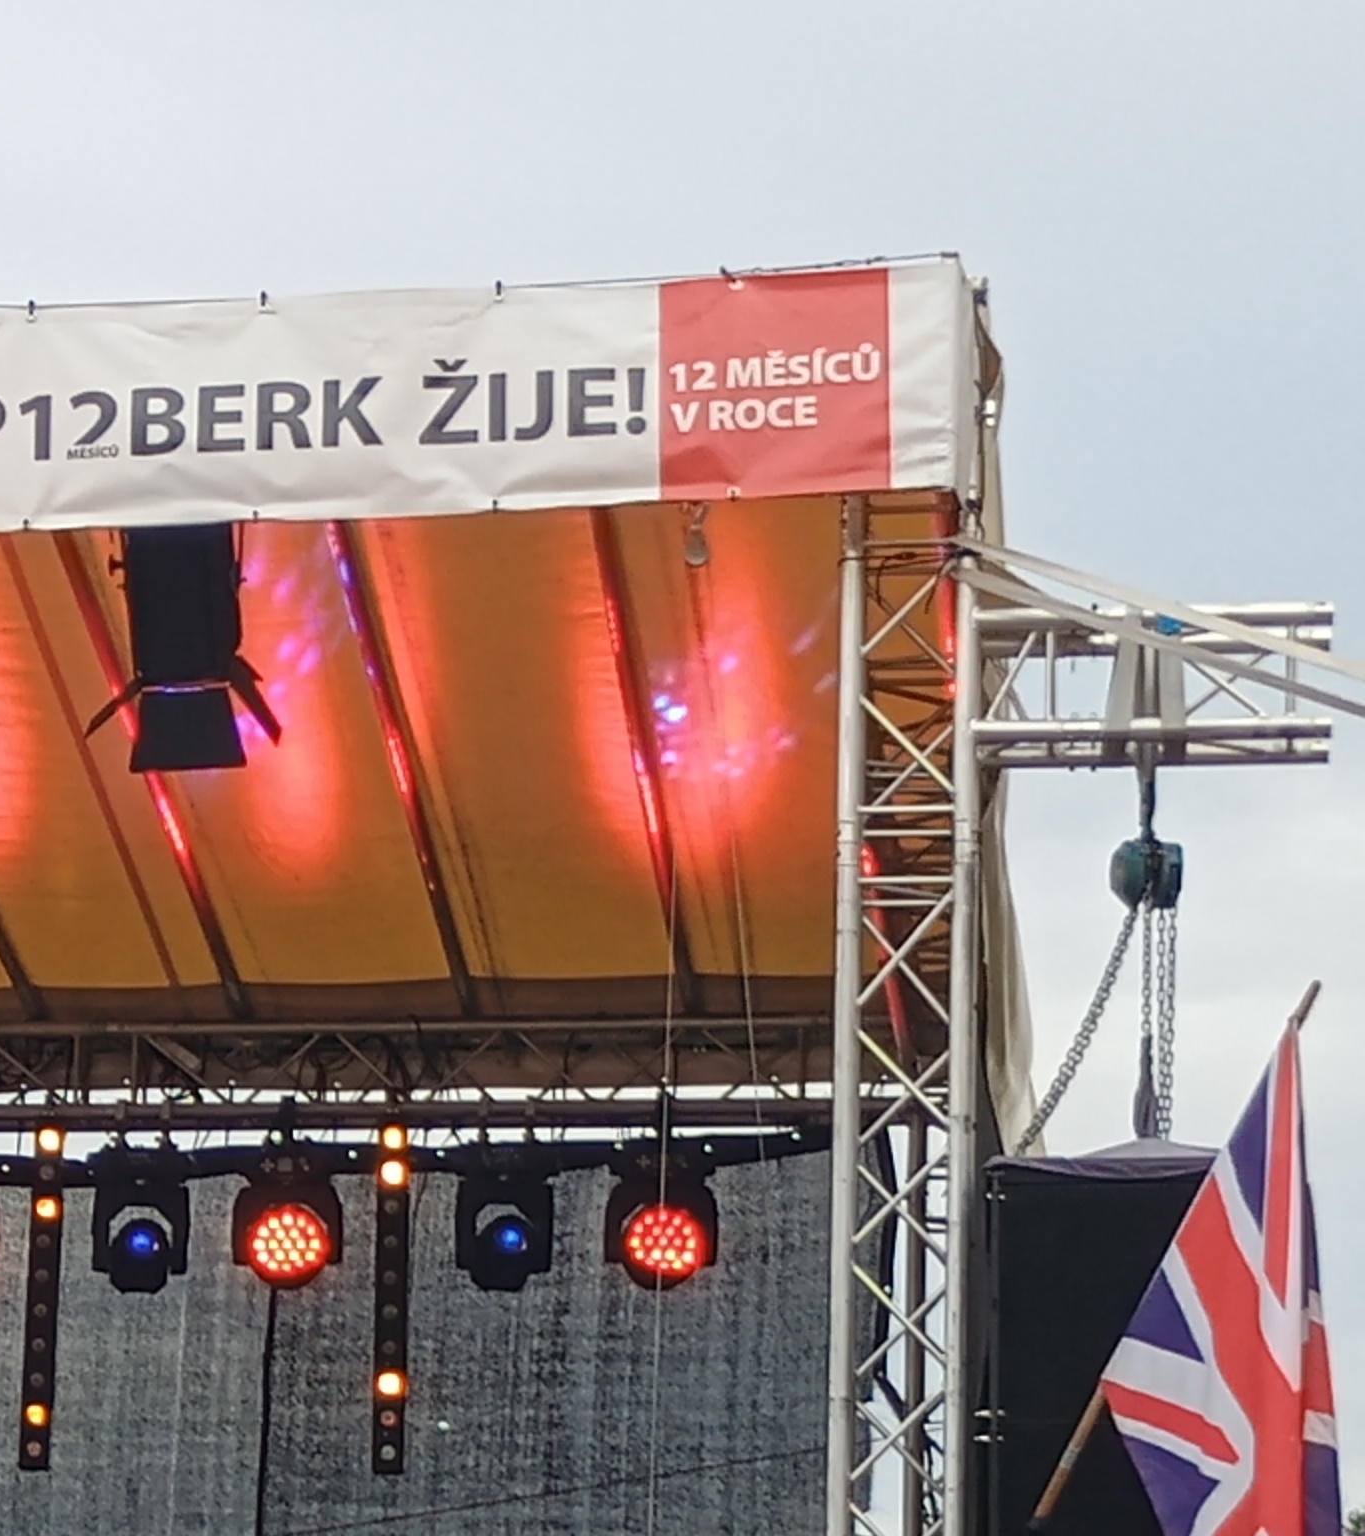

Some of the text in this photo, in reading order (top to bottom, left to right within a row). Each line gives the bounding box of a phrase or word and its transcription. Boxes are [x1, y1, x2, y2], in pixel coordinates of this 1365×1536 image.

[669, 342, 881, 392] 12 MĚSÍCŮ
[418, 358, 647, 445] ŽIJE!
[670, 395, 818, 433] V ROCE
